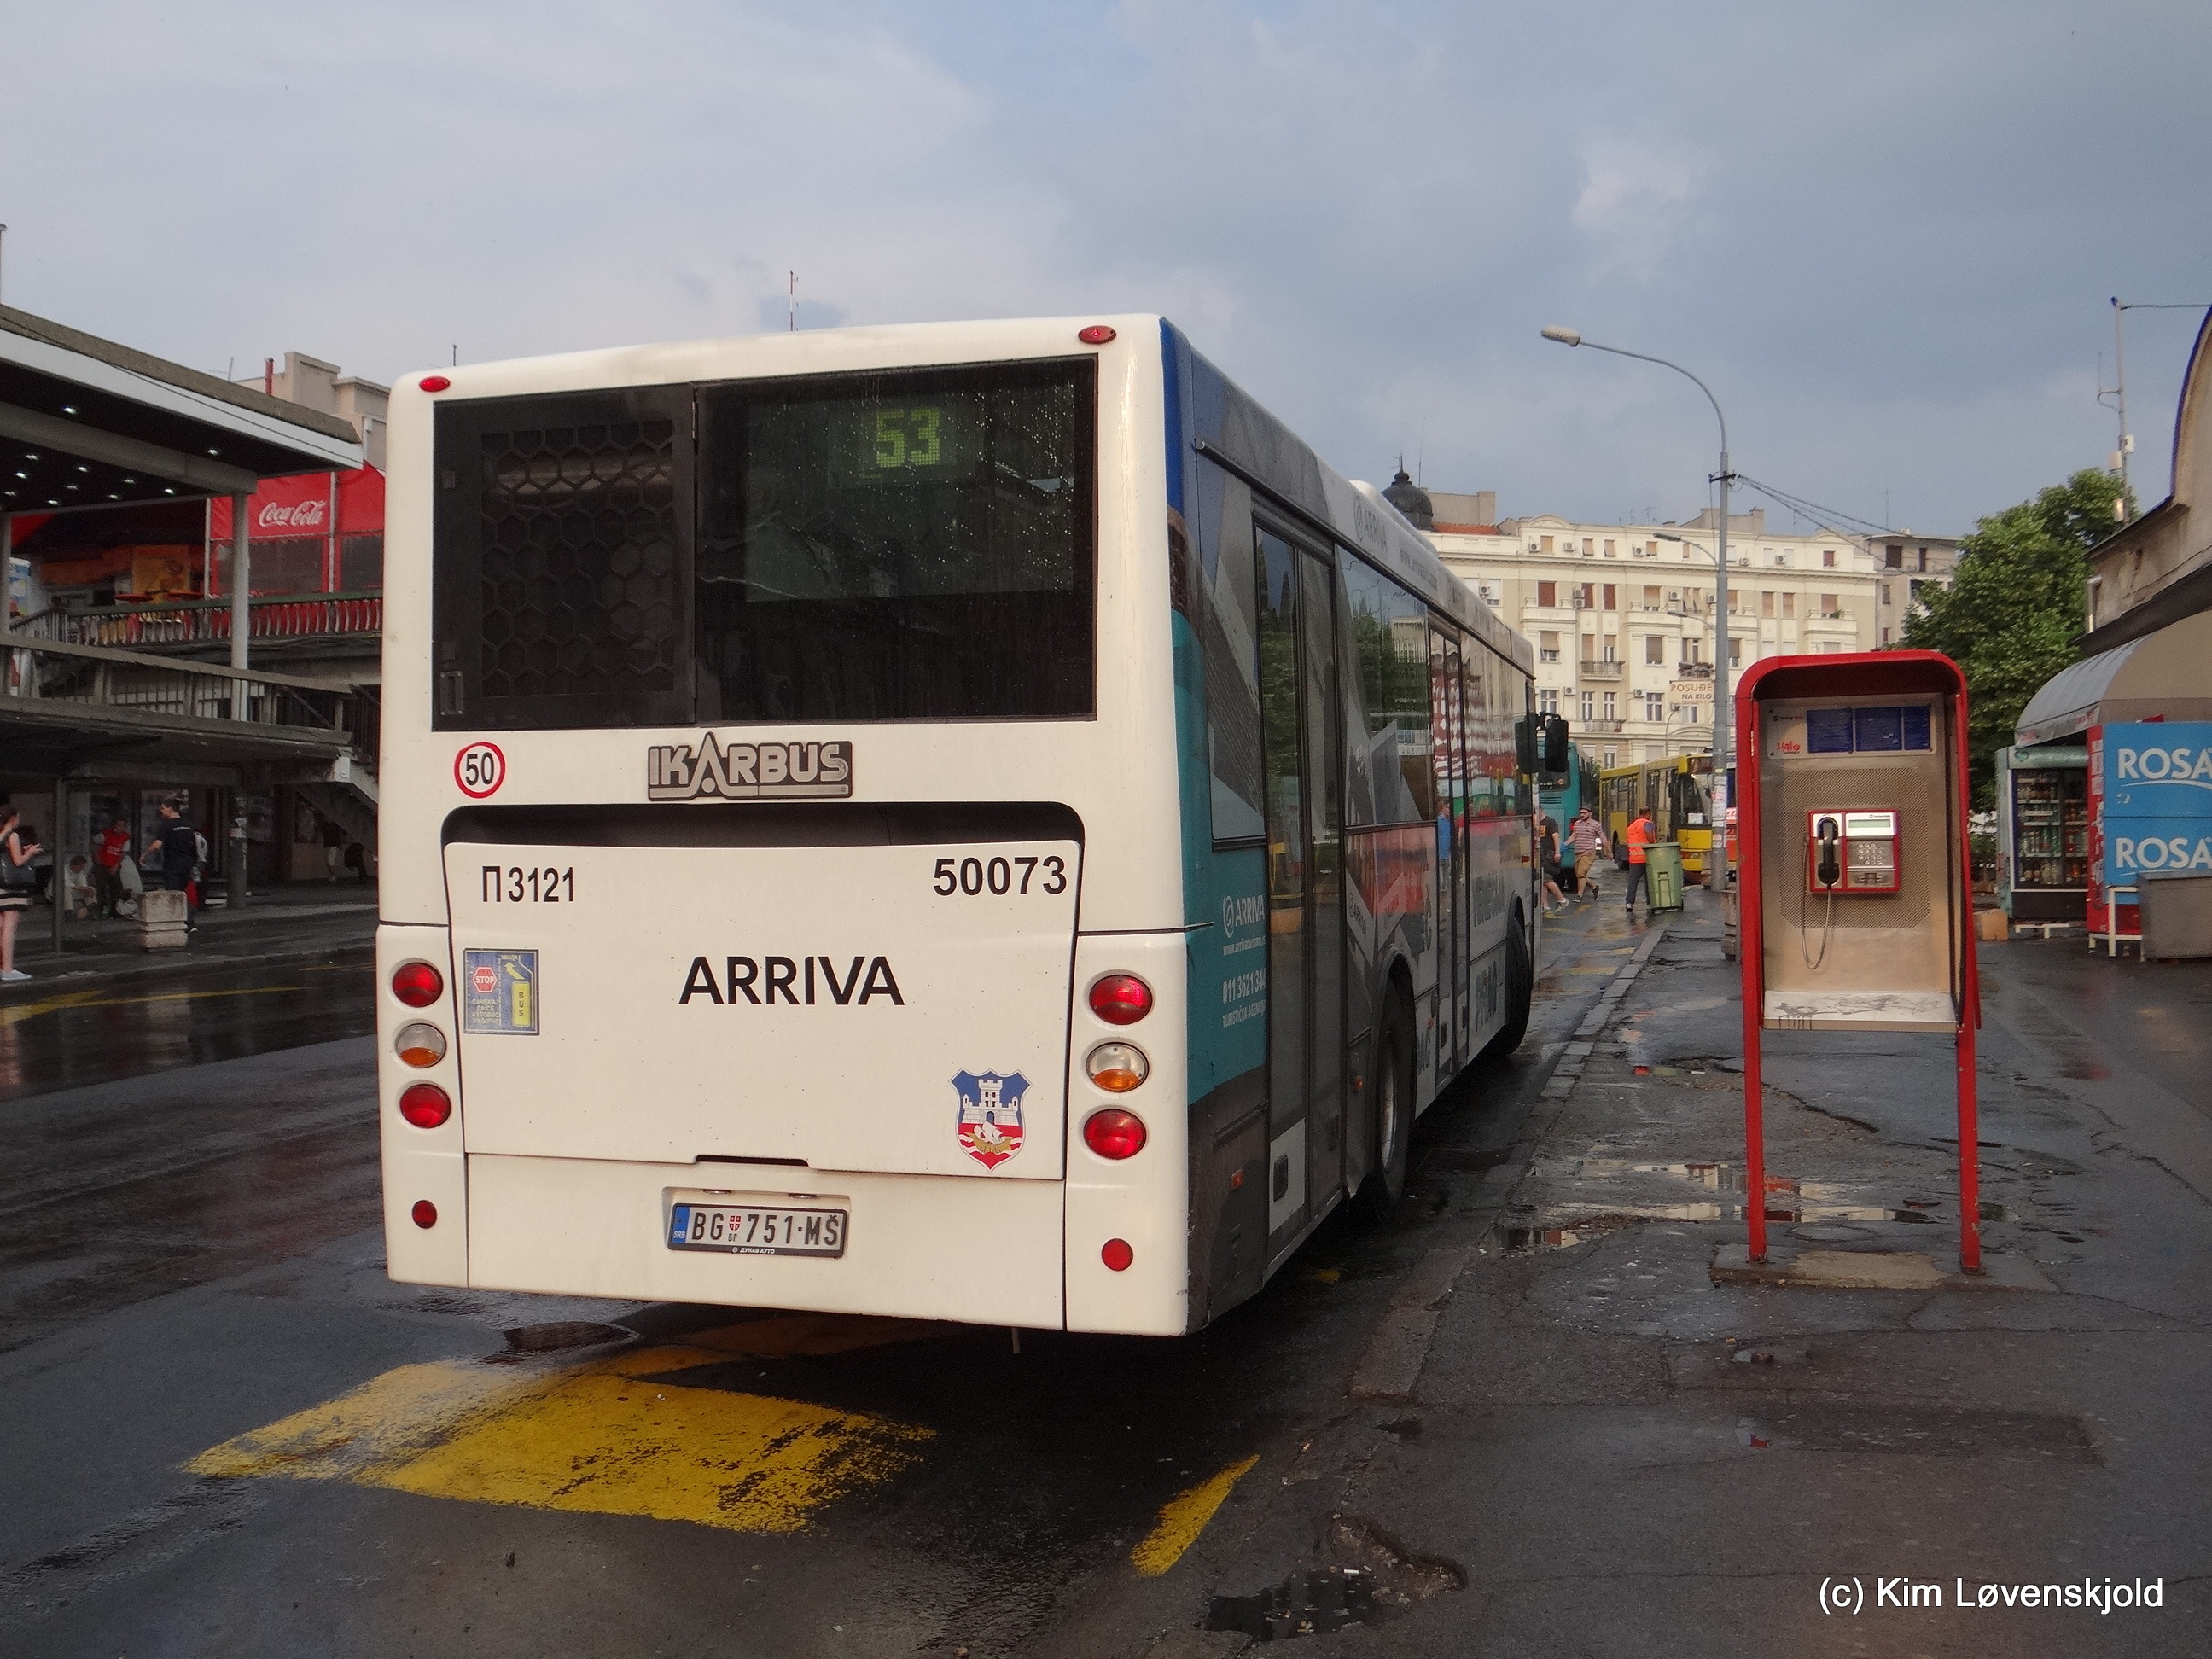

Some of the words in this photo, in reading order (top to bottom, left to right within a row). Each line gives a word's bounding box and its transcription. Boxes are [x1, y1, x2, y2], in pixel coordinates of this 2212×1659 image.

[876, 408, 940, 468] 53
[259, 499, 326, 527] Coca-Cola
[465, 752, 494, 786] 50
[649, 732, 850, 797] IKARBUS
[2117, 747, 2212, 780] ROSA
[2115, 836, 2212, 869] ROSA
[933, 856, 1068, 896] 50073
[1235, 894, 1266, 927] ARRIVA
[475, 975, 495, 984] STOP
[678, 956, 905, 1006] ARRIVA
[1222, 977, 1236, 1004] 011
[1237, 972, 1254, 999] 3621
[673, 1231, 685, 1239] SRB
[692, 1212, 725, 1241] BG
